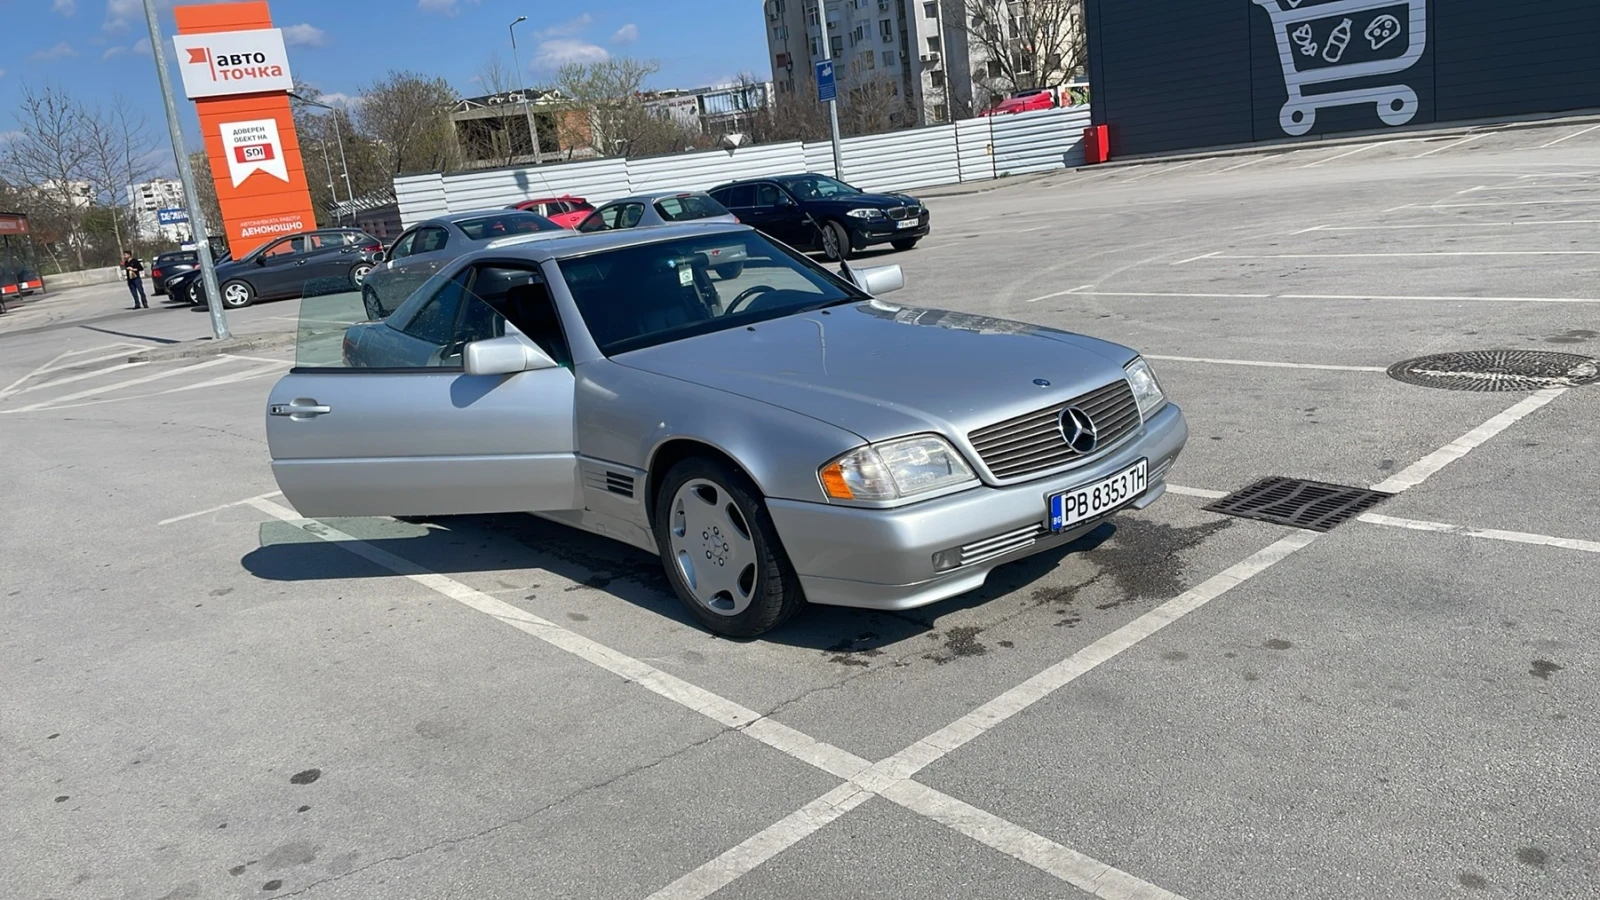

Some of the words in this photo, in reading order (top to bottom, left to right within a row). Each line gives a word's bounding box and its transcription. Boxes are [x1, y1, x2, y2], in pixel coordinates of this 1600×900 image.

[217, 52, 265, 66] авто
[219, 65, 282, 80] точка
[233, 126, 265, 136] ДОВЕРЕН
[234, 135, 256, 143] ОБЕКТ
[245, 148, 263, 157] SDI
[241, 221, 303, 237] ДЕНОНОЩНО
[1065, 492, 1088, 521] PB
[1092, 475, 1127, 510] 8353
[1129, 464, 1145, 493] TH
